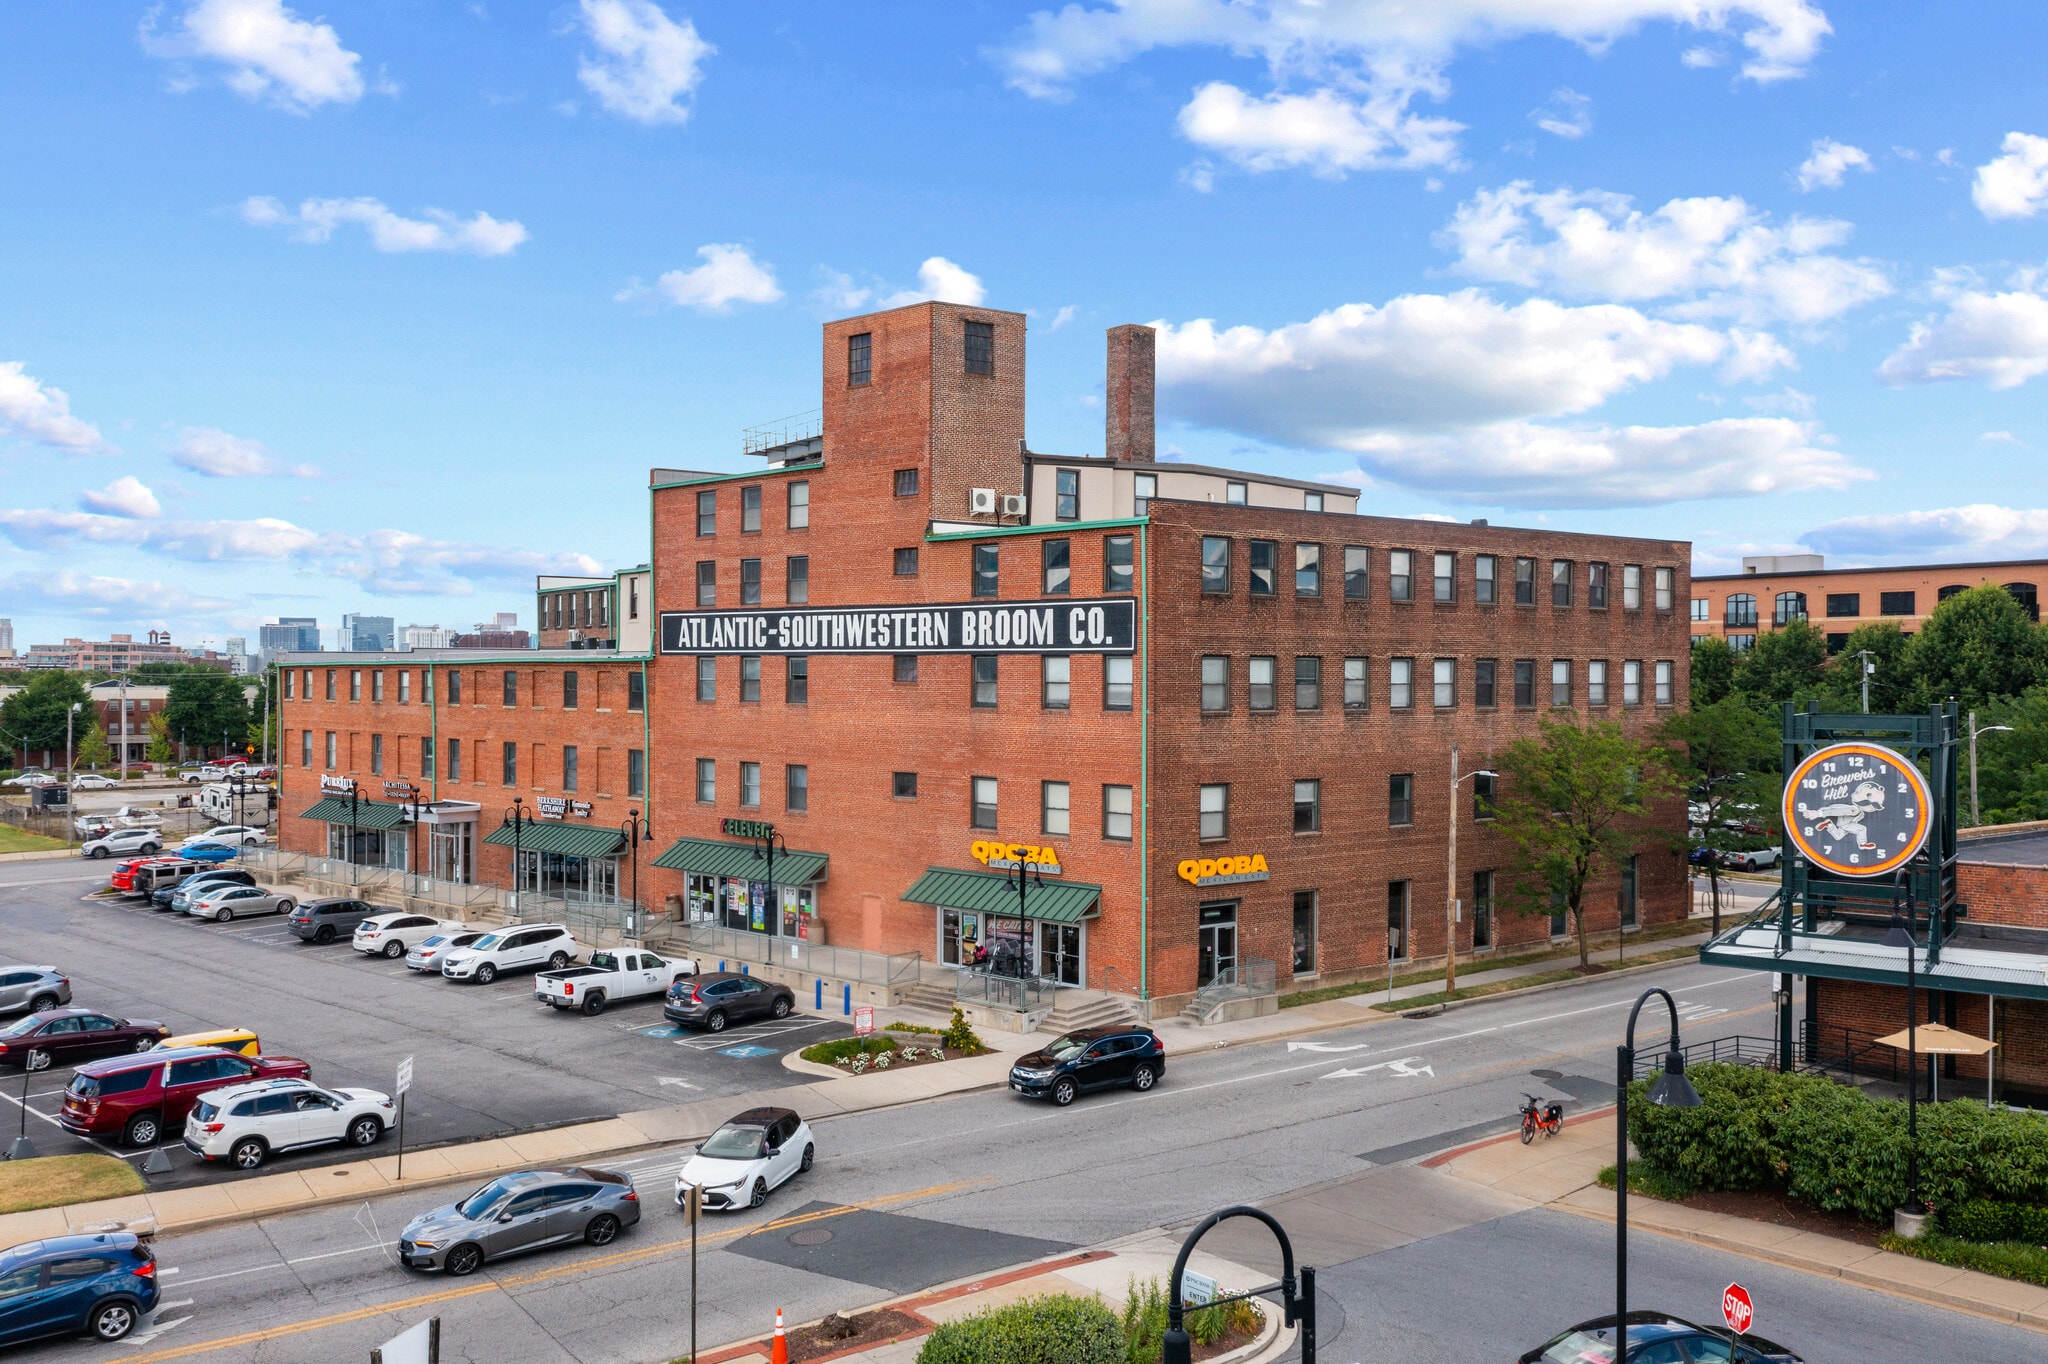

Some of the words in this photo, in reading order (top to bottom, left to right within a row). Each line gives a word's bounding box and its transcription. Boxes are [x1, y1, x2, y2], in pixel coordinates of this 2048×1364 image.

[678, 611, 949, 648] ATLANTIC-SOUTHWESTERN
[962, 608, 1054, 646] BROOM
[1069, 606, 1113, 645] CO.
[1848, 757, 1864, 767] 12
[1823, 763, 1836, 772] 11
[1879, 765, 1887, 774] 1
[1821, 768, 1876, 788] Brewers
[1802, 779, 1818, 789] 10
[1898, 783, 1908, 793] 2
[1823, 785, 1849, 800] Hill
[1797, 803, 1807, 812] 9
[1905, 808, 1914, 818] 3
[1804, 827, 1814, 837] 8
[1897, 833, 1907, 842] 4
[970, 840, 1059, 865] QDOBA
[1824, 846, 1833, 855] 7
[1877, 849, 1886, 859] 5
[1850, 854, 1859, 863] 6
[1177, 854, 1269, 885] QDOBA
[1199, 874, 1241, 884] MEXICAN
[1003, 920, 1031, 930] CATR
[1189, 1291, 1207, 1302] ENTER
[1725, 1293, 1751, 1321] STOP
